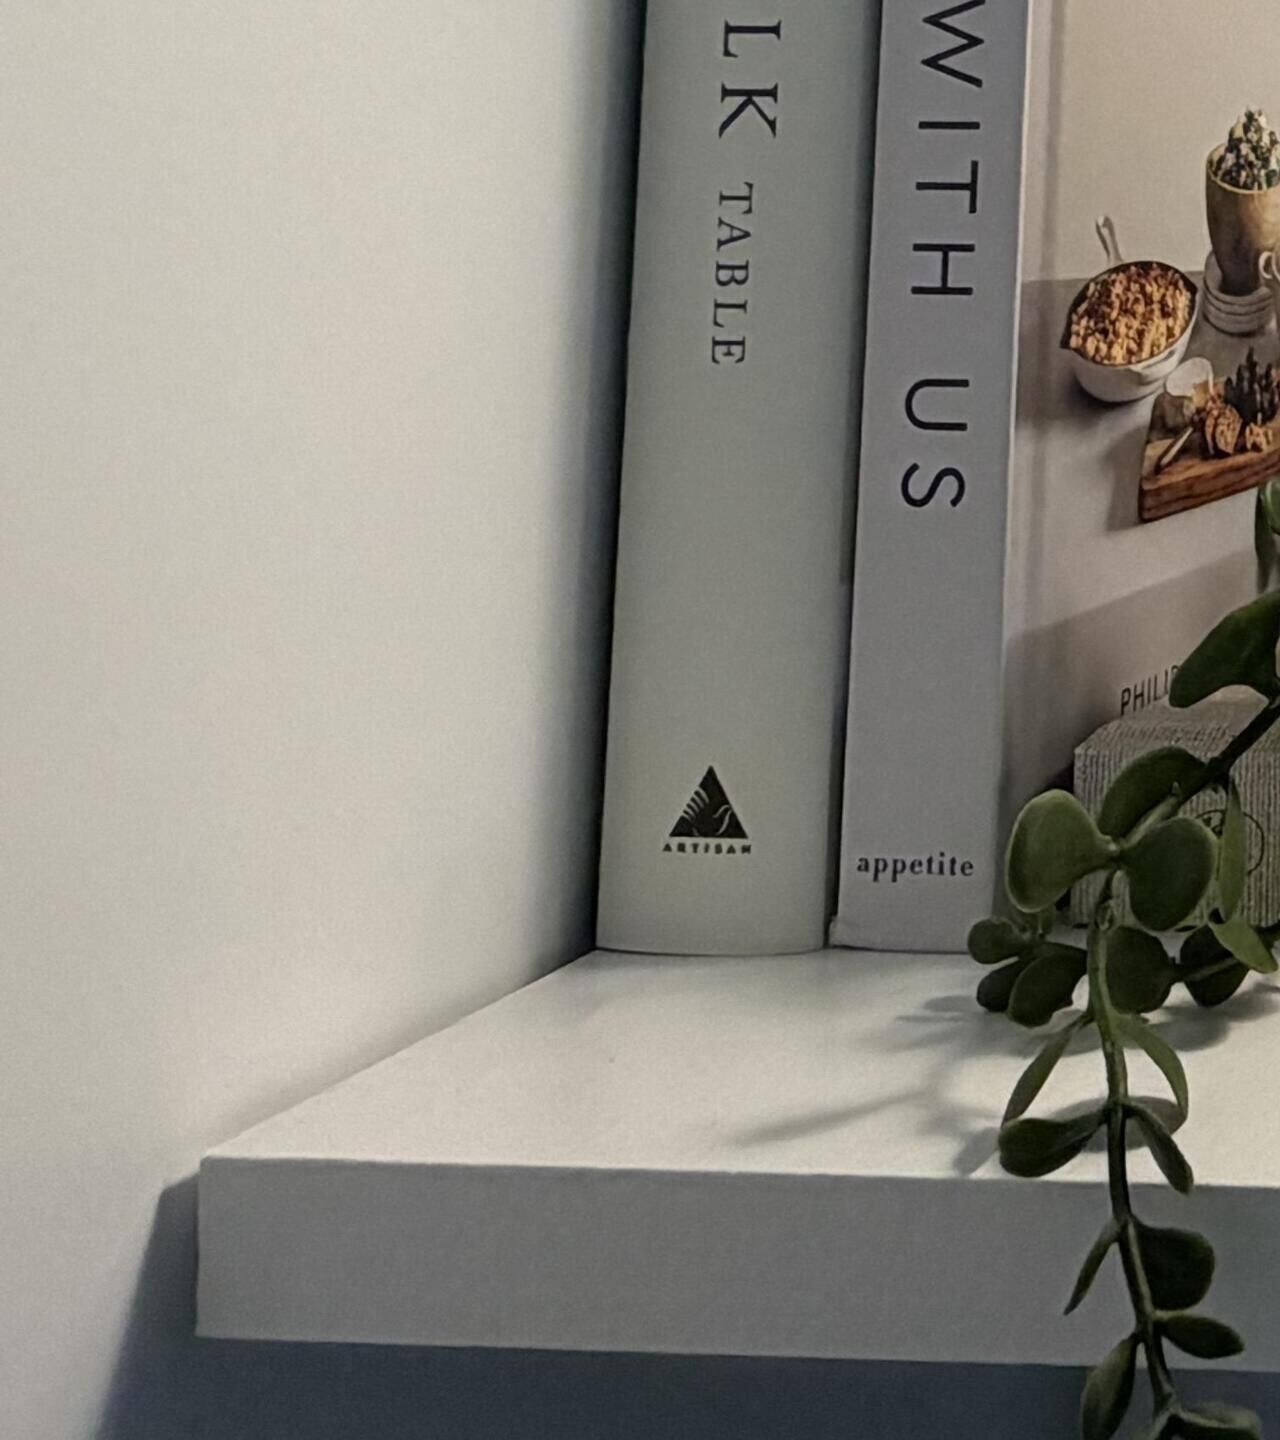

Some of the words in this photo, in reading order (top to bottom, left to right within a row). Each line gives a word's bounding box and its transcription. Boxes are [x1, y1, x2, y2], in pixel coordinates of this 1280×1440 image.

[710, 181, 754, 366] TABLE
[900, 379, 970, 509] US
[662, 842, 752, 854] ARTISAN
[857, 852, 974, 882] appetite
